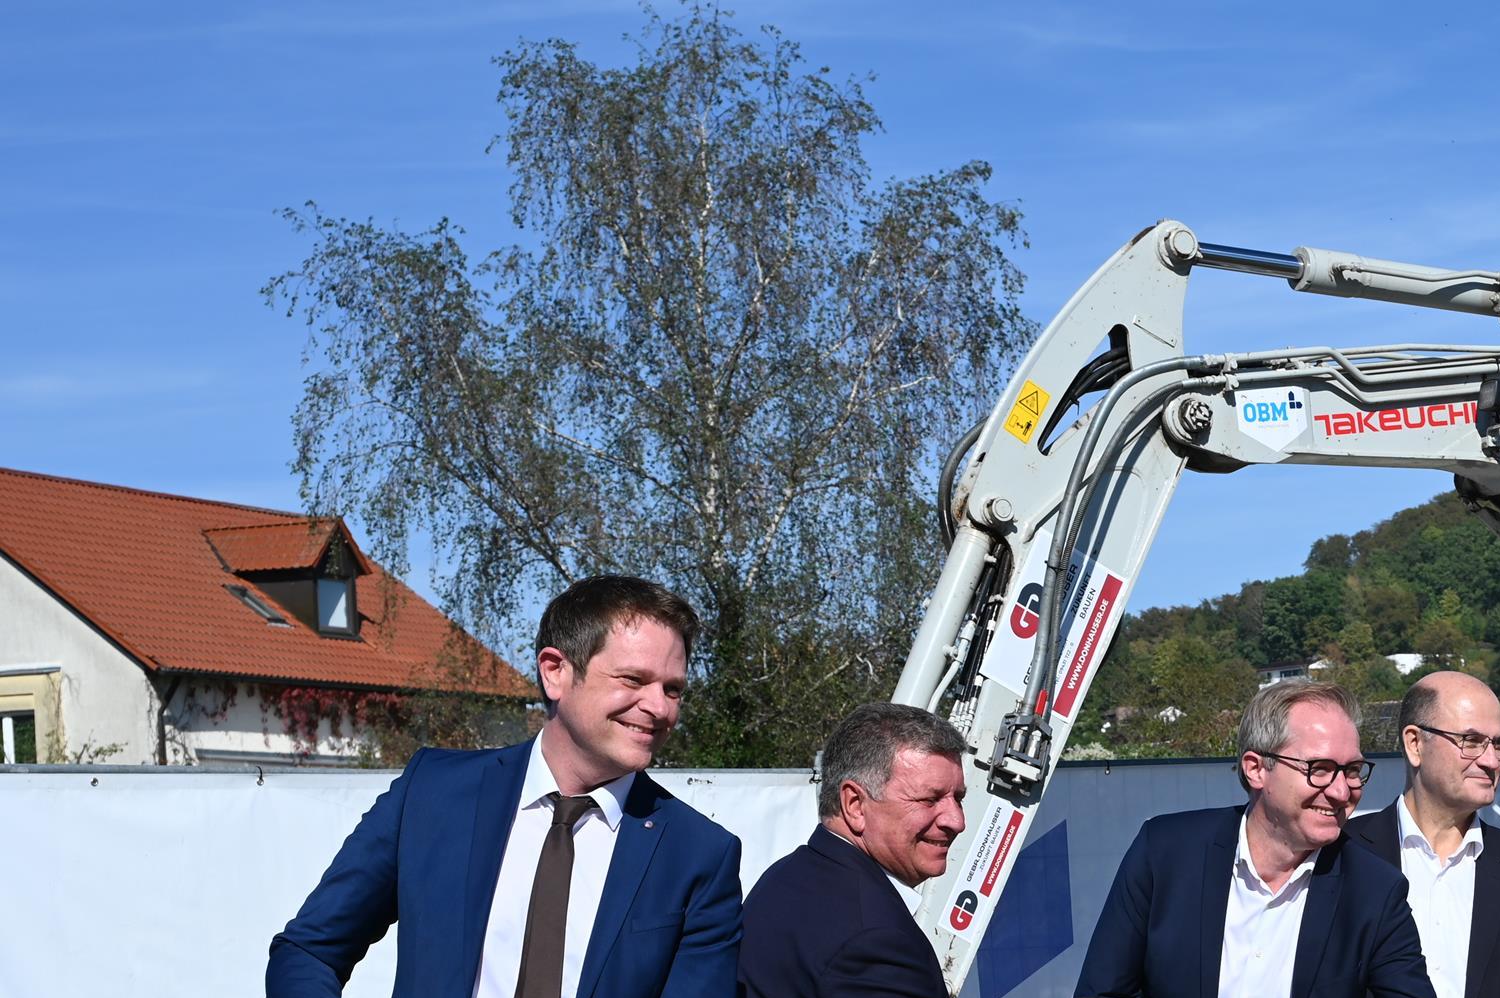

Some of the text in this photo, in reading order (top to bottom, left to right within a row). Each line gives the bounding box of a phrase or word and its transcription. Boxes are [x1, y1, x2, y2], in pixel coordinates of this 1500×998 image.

[1243, 402, 1288, 422] OBM
[1079, 587, 1096, 620] BAUEN
[1067, 598, 1109, 690] WWW.DONHAUSER.DE
[987, 825, 1016, 885] WWW.DONHAUSER.DE
